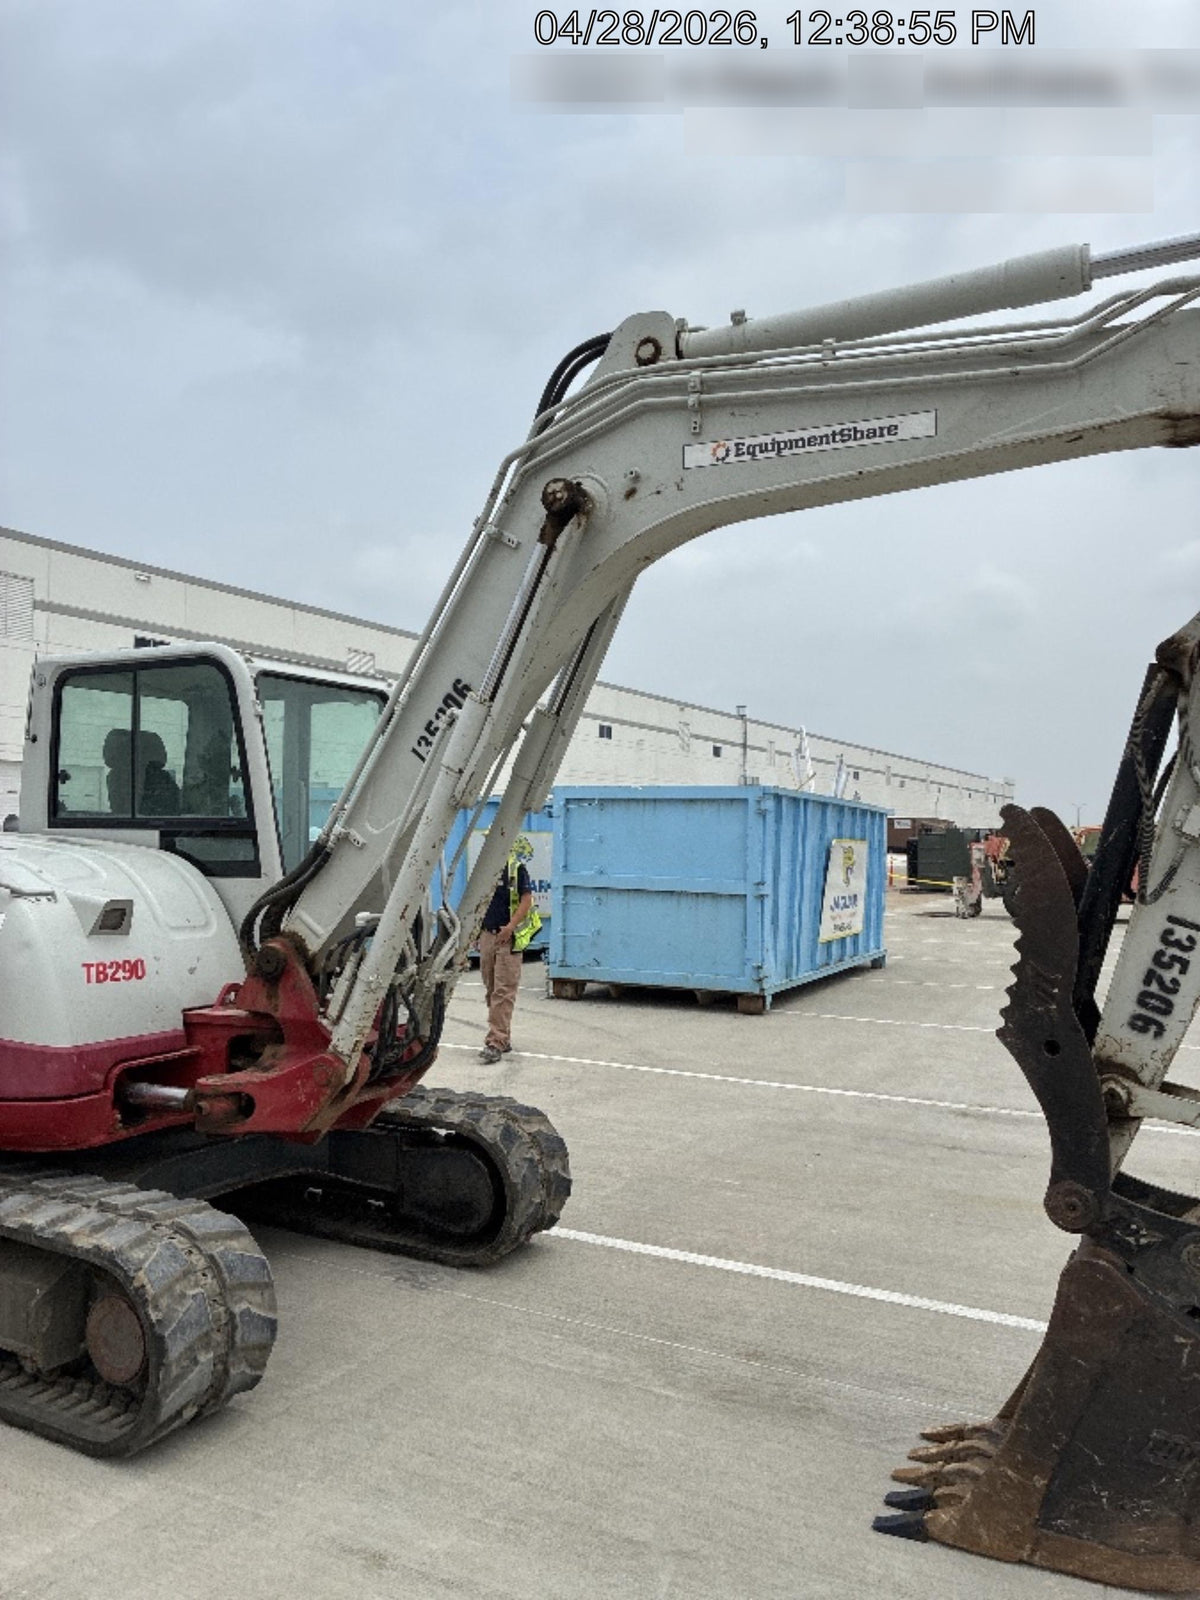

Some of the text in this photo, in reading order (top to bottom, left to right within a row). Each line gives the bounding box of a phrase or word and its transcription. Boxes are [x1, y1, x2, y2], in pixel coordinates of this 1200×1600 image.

[734, 423, 899, 458] EquipmentShare
[82, 958, 146, 984] TB290
[1128, 915, 1200, 1040] 135206
